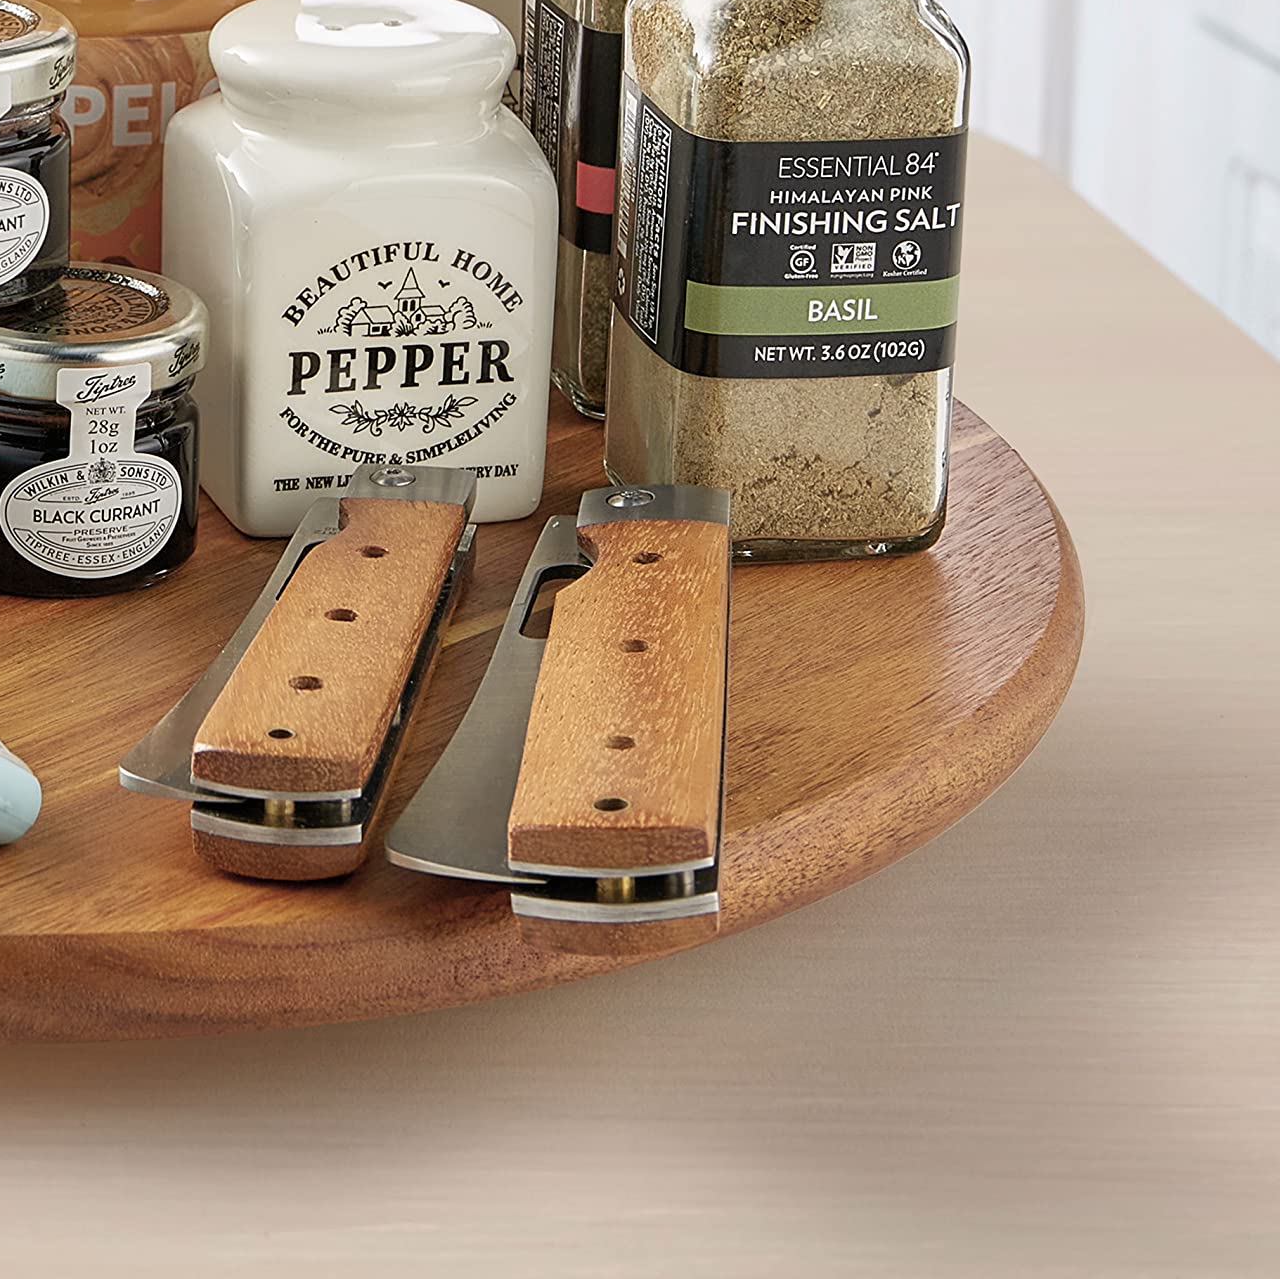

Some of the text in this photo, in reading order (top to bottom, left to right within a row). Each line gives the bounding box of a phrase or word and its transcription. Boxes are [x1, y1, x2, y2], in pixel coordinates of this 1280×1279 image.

[552, 21, 563, 144] Nutrition Facts
[658, 128, 670, 209] Nutrition
[777, 155, 902, 179] ESSENTIAL
[14, 185, 33, 203] LTD
[769, 185, 934, 204] HIMALAYAN PINK
[731, 202, 962, 235] FINISHING SALT
[654, 213, 663, 259] Facts
[795, 257, 809, 267] GF
[281, 241, 524, 327] BEAUTIFUL HOME
[807, 298, 878, 322] BASIL
[754, 339, 926, 362] NET WT. 3.6 OZ (102G)
[286, 339, 515, 396] PEPPER
[74, 374, 137, 405] Tiptree
[85, 405, 127, 416] NET WT.
[88, 420, 120, 437] 28g
[279, 407, 310, 438] FOR
[307, 430, 342, 457] THE
[341, 445, 387, 465] PURE
[388, 453, 403, 466] &
[90, 438, 119, 454] 1oz
[23, 466, 168, 498] WILKIN & SONS LTD
[273, 478, 300, 492] THE
[305, 475, 335, 490] NEW
[494, 463, 519, 478] DAY
[83, 487, 120, 505] Tiptree
[33, 499, 161, 525] BLACK CURRANT
[24, 522, 167, 565] TIPTREE ESSEX ENGLAND
[73, 525, 129, 536] PRESERVE
